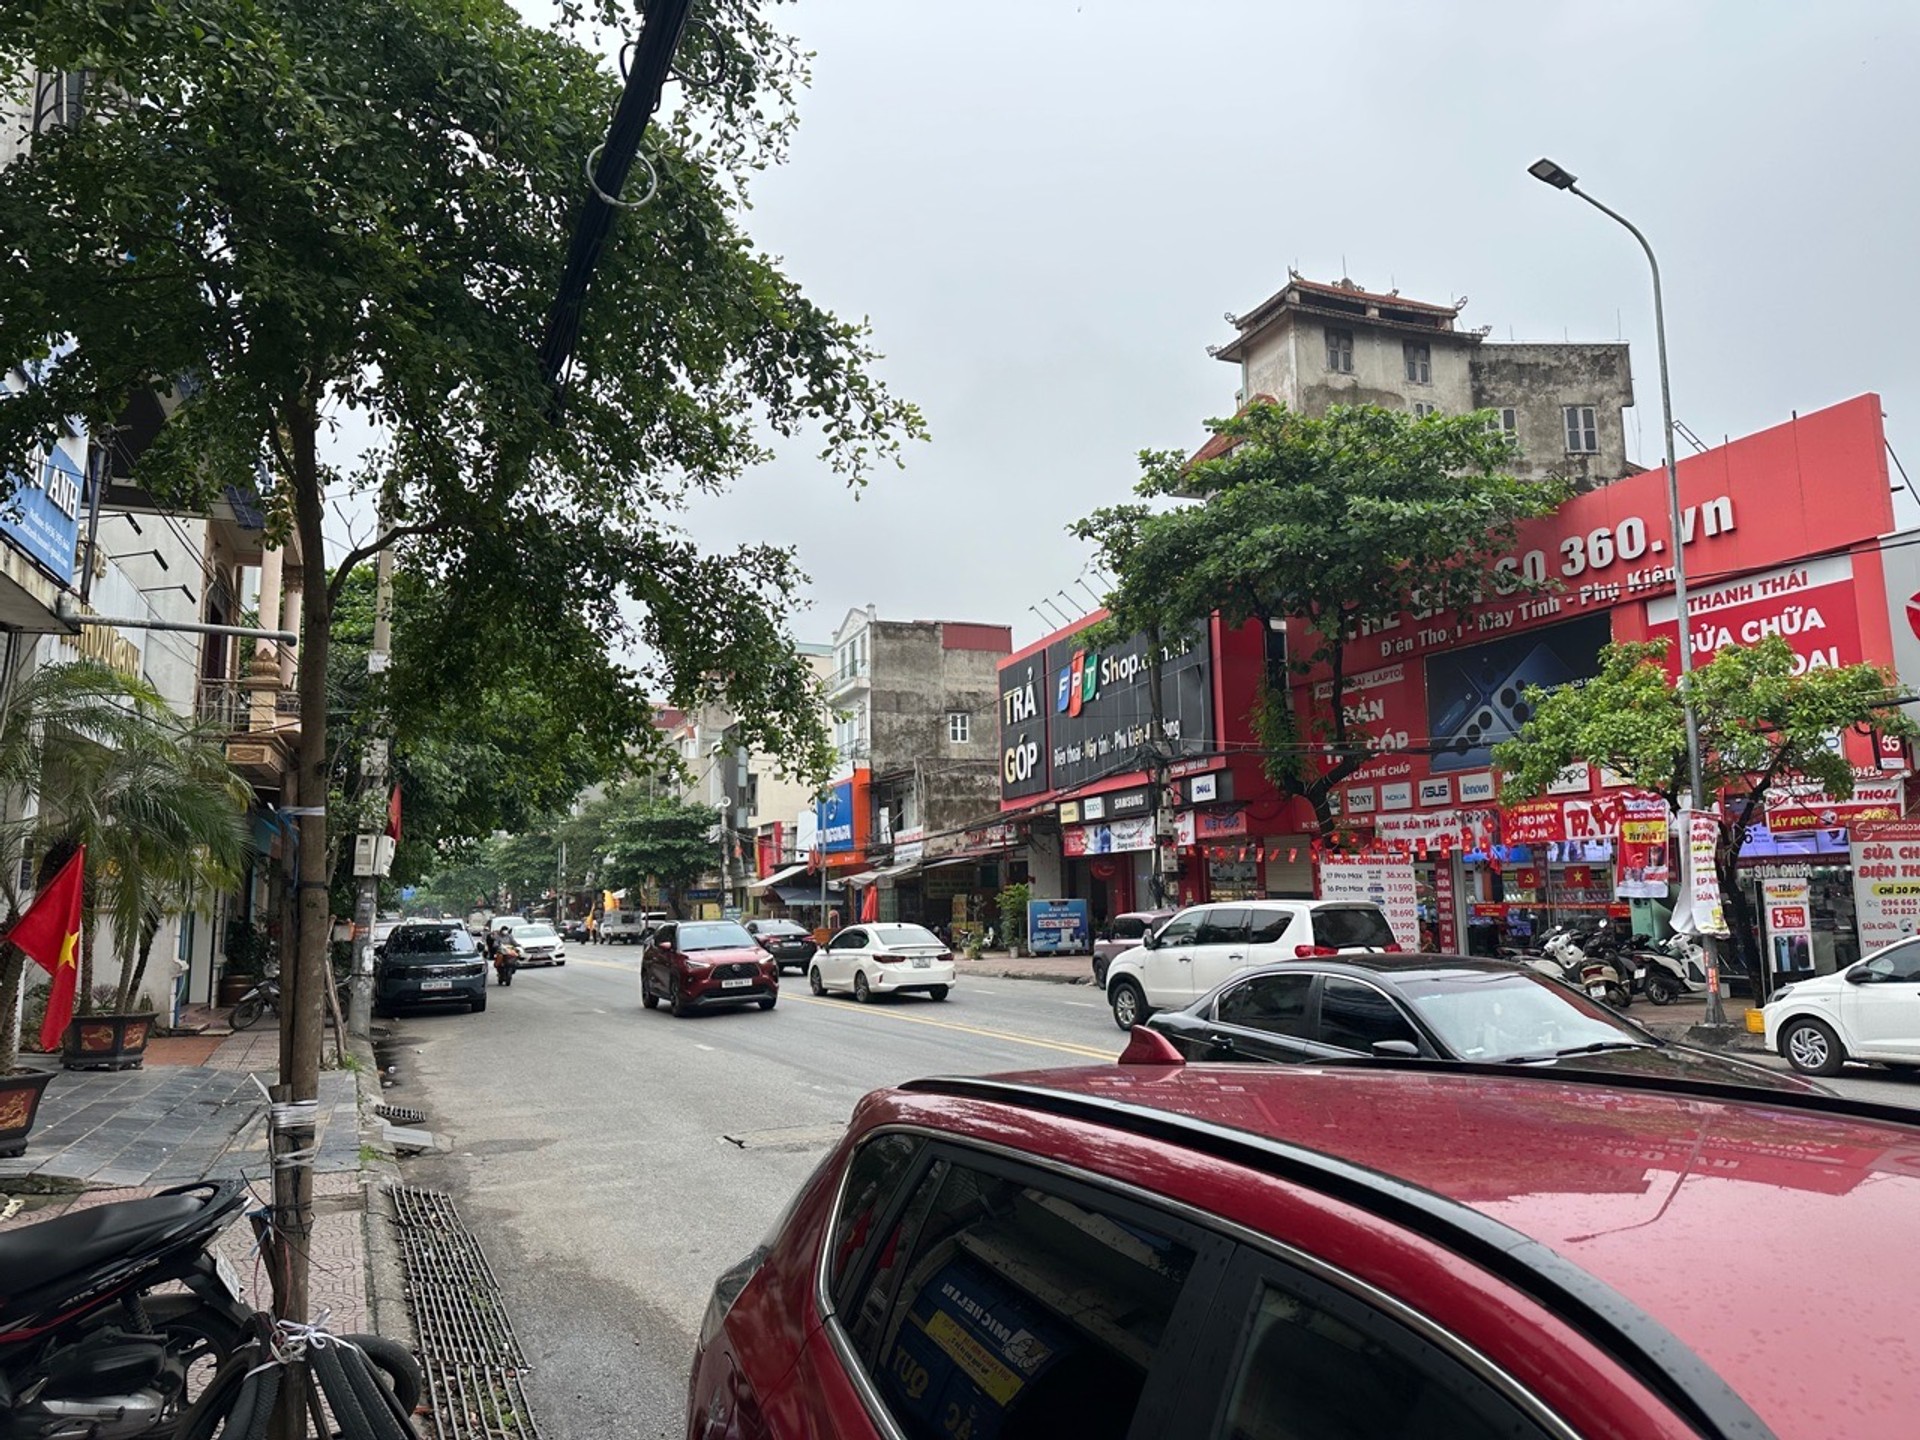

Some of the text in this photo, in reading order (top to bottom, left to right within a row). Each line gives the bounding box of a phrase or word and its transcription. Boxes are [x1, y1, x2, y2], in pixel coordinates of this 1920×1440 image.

[48, 465, 80, 521] ANH
[1560, 495, 1737, 577] 360.vn
[1518, 595, 1562, 619] Tính
[1579, 579, 1621, 606] Phụ
[1627, 563, 1677, 593] Kiện
[1688, 570, 1808, 612] THANH THÁI
[1741, 605, 1827, 643] CHỮA
[1002, 666, 1038, 726] TRẢ
[1881, 735, 1900, 752] 5G
[1003, 733, 1039, 785] GÓP
[1349, 794, 1373, 807] SONY
[1421, 784, 1448, 798] ASUS
[1857, 788, 1899, 802] THOẠI
[1114, 794, 1144, 809] SAMSUNG
[1862, 843, 1895, 860] SỬA
[1858, 862, 1897, 881] ĐIỆN
[1774, 909, 1785, 927] 3
